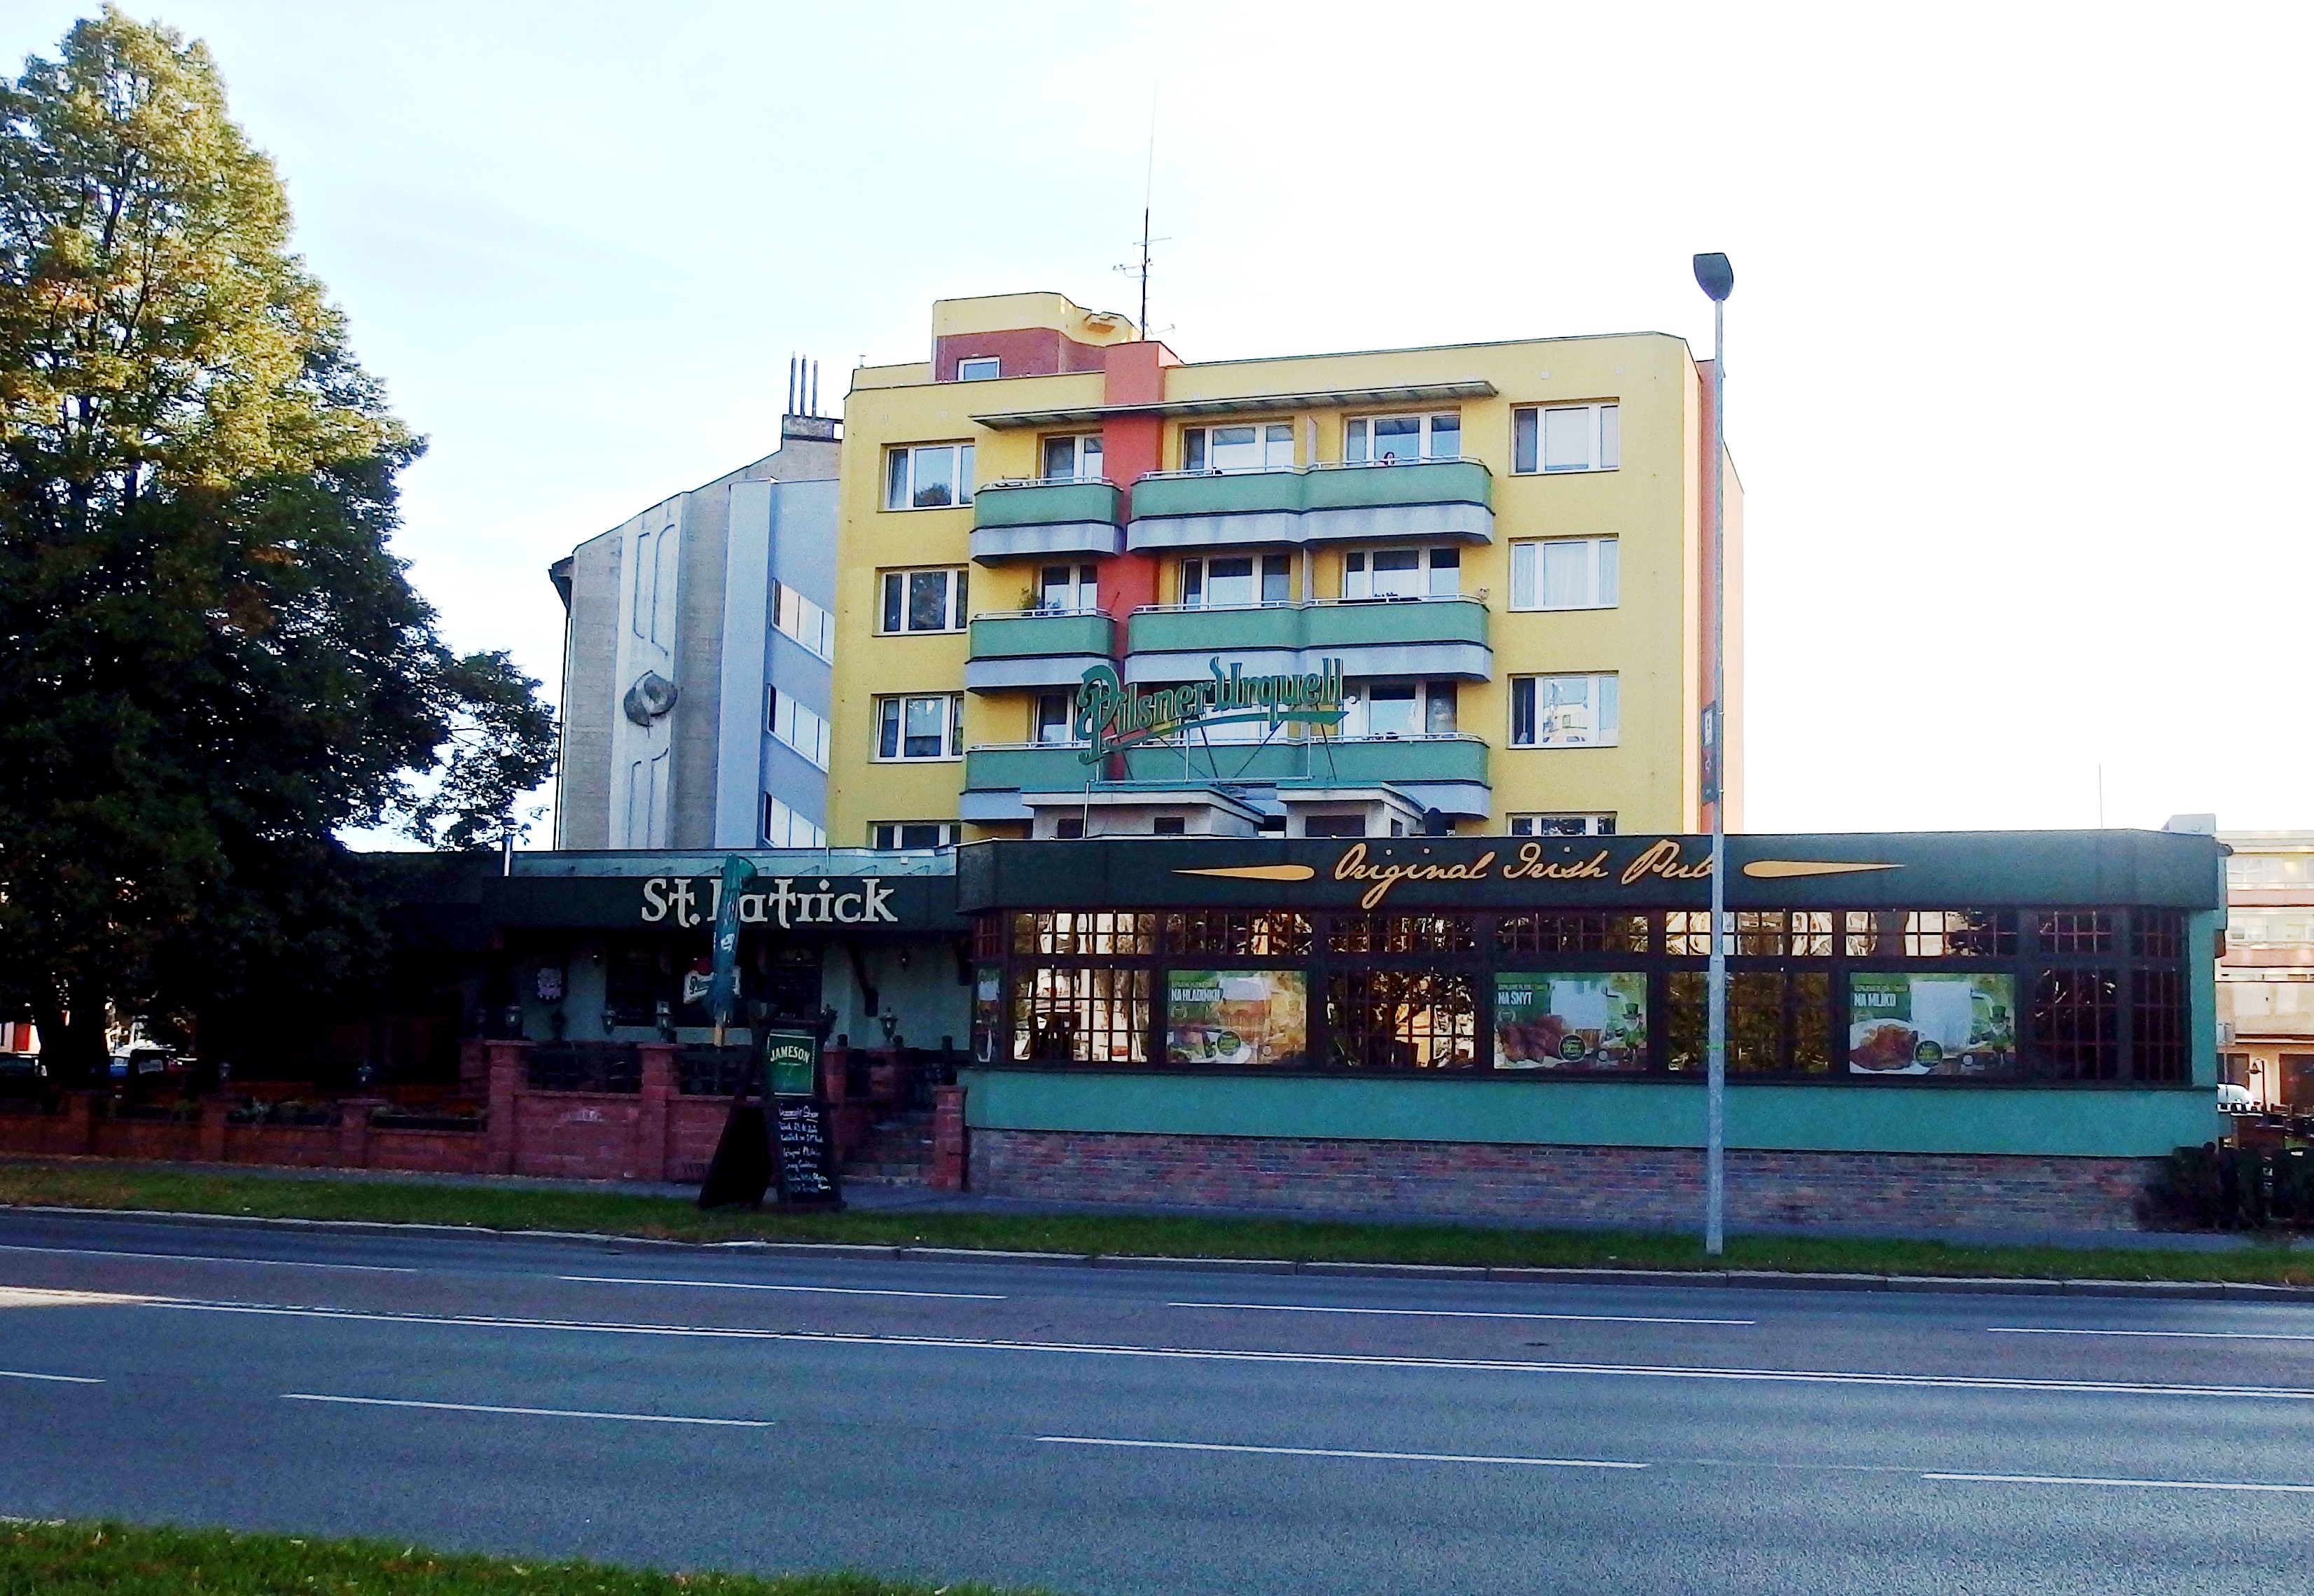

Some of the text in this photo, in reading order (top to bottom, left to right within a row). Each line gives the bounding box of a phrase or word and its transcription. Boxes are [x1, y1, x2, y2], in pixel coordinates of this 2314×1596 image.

[1074, 656, 1344, 766] Pilsner Urquell
[642, 877, 700, 928] St.
[1334, 842, 1496, 910] Original
[1504, 842, 1609, 880] Irish
[770, 1046, 810, 1064] JAMESON
